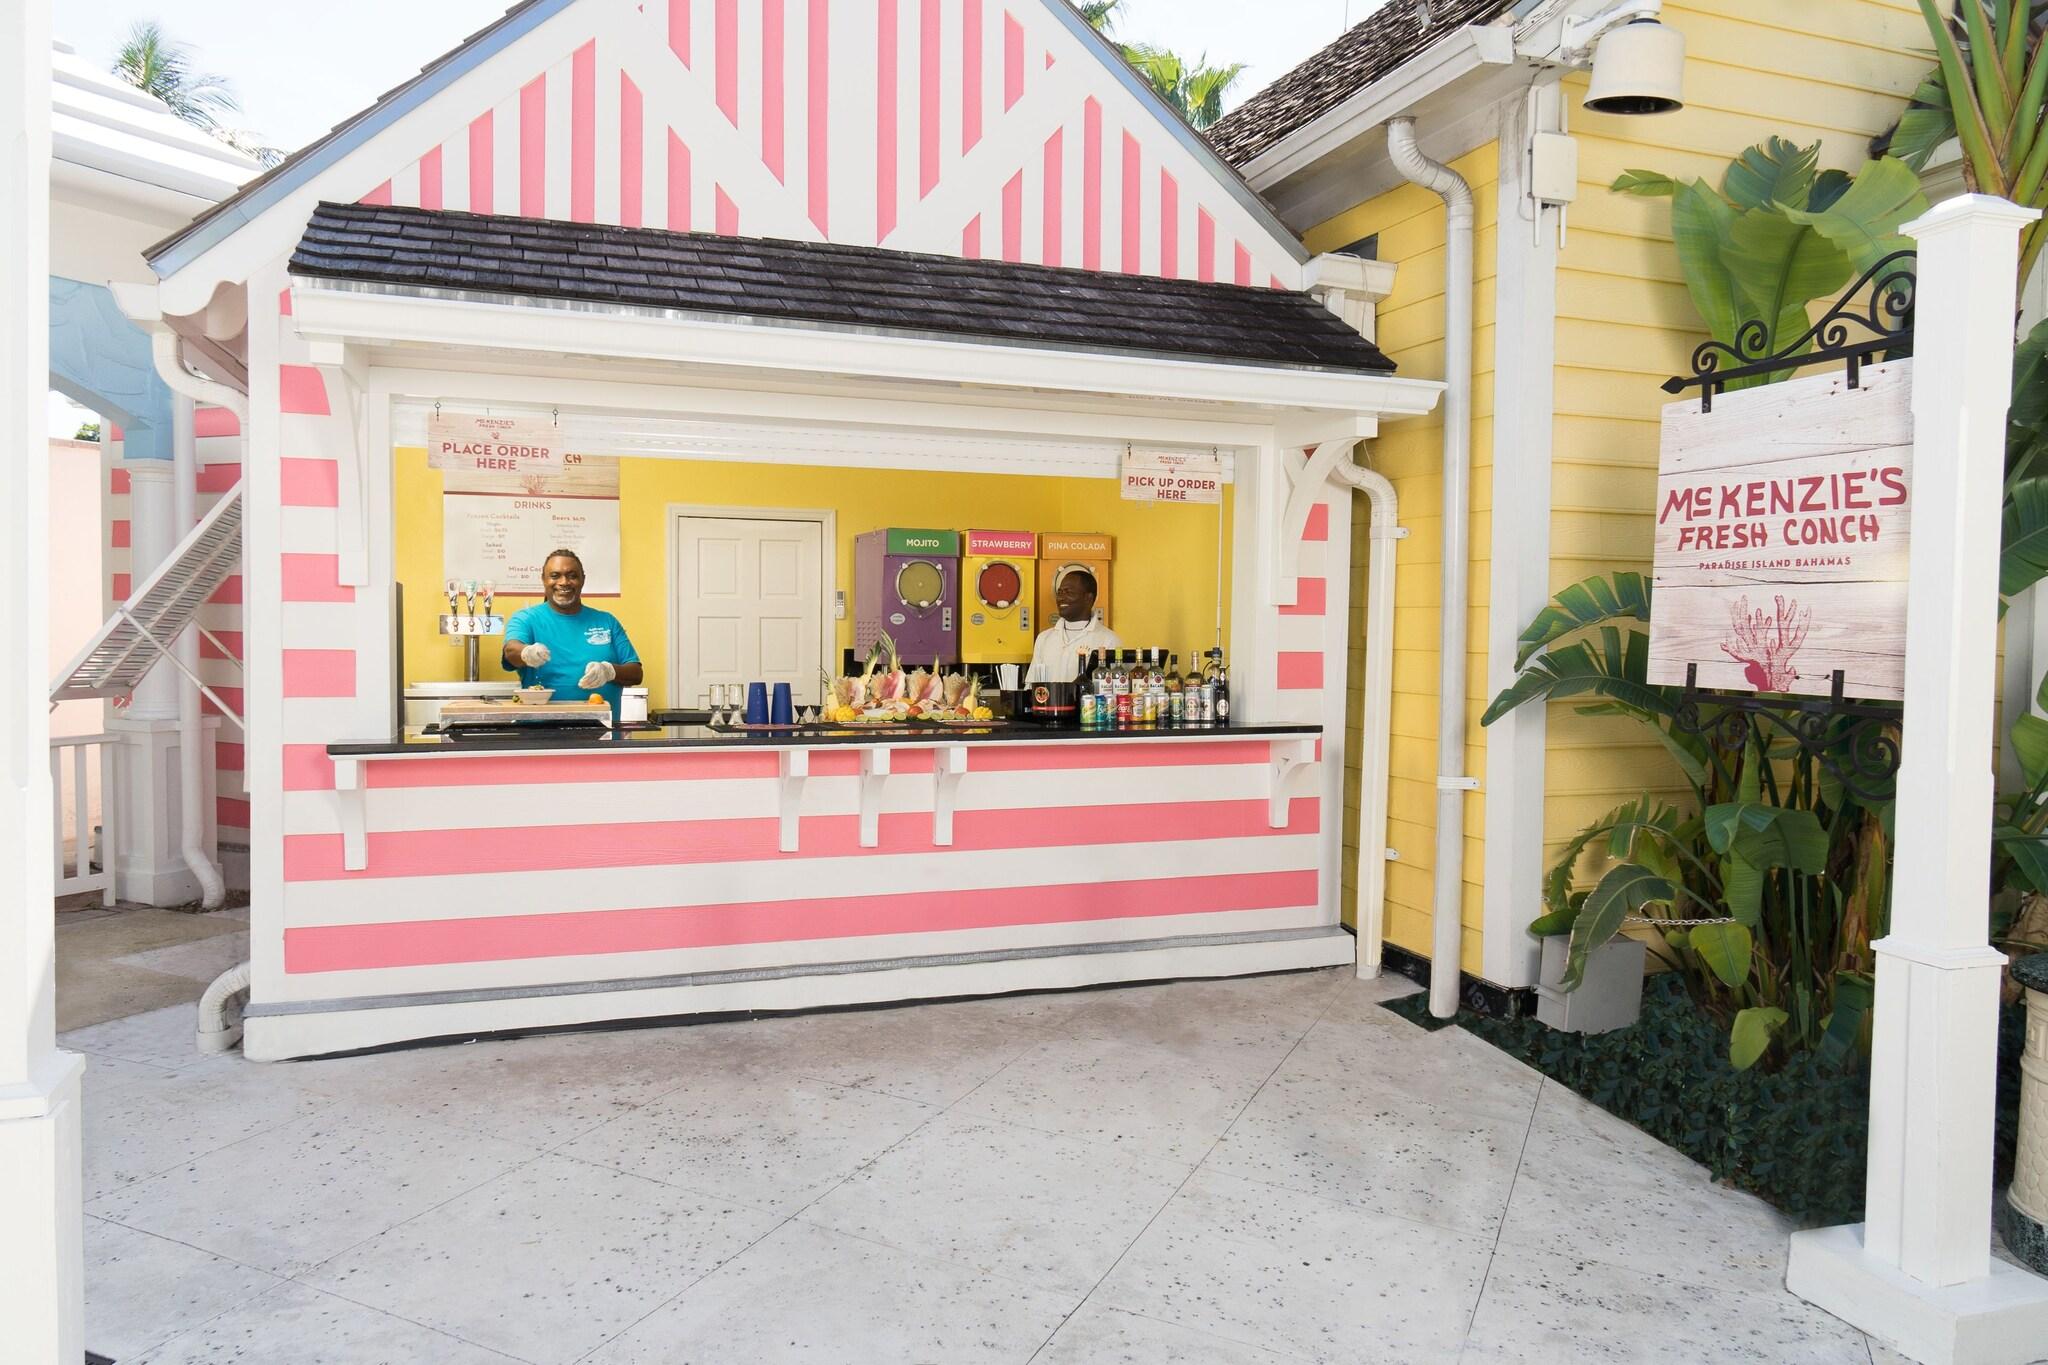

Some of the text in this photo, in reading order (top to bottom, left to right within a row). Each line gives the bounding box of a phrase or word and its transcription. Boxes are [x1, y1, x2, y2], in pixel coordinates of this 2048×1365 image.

[442, 442, 550, 458] PLACE ORDER
[477, 458, 517, 470] HERE
[1128, 476, 1216, 490] PICK UP ORDER
[1157, 489, 1186, 499] HERE
[514, 501, 552, 509] DRINKS
[1678, 514, 1880, 551] FRESH CONCH
[906, 539, 939, 548] MOJITO
[971, 540, 1032, 549] STRAWBERRY
[1071, 542, 1106, 551] COLADA
[1699, 556, 1851, 570] PARADISE ISLAND BAHAMAS
